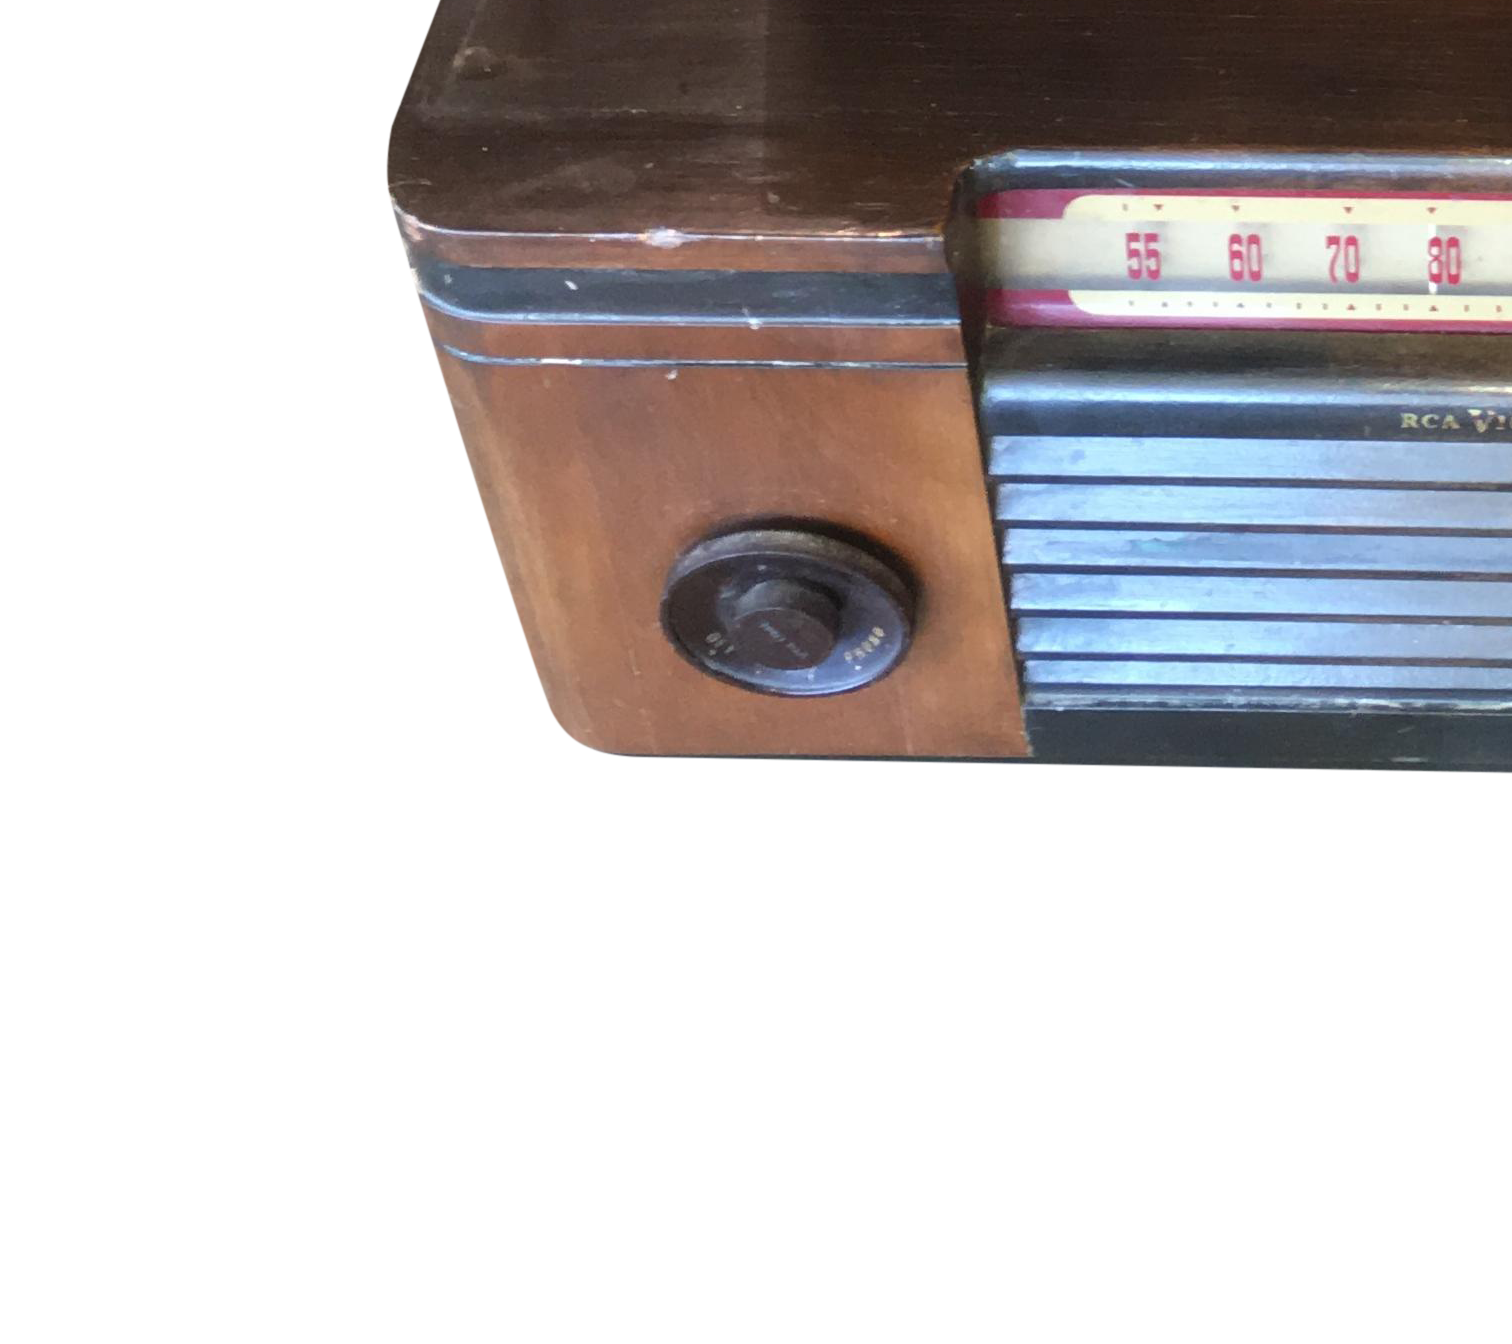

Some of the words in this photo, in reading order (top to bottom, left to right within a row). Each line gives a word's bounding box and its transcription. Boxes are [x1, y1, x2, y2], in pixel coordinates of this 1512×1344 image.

[1126, 232, 1161, 281] 55
[1228, 234, 1263, 282] 60
[1326, 234, 1360, 283] 70
[1428, 236, 1462, 285] 80
[1400, 413, 1461, 430] RCA
